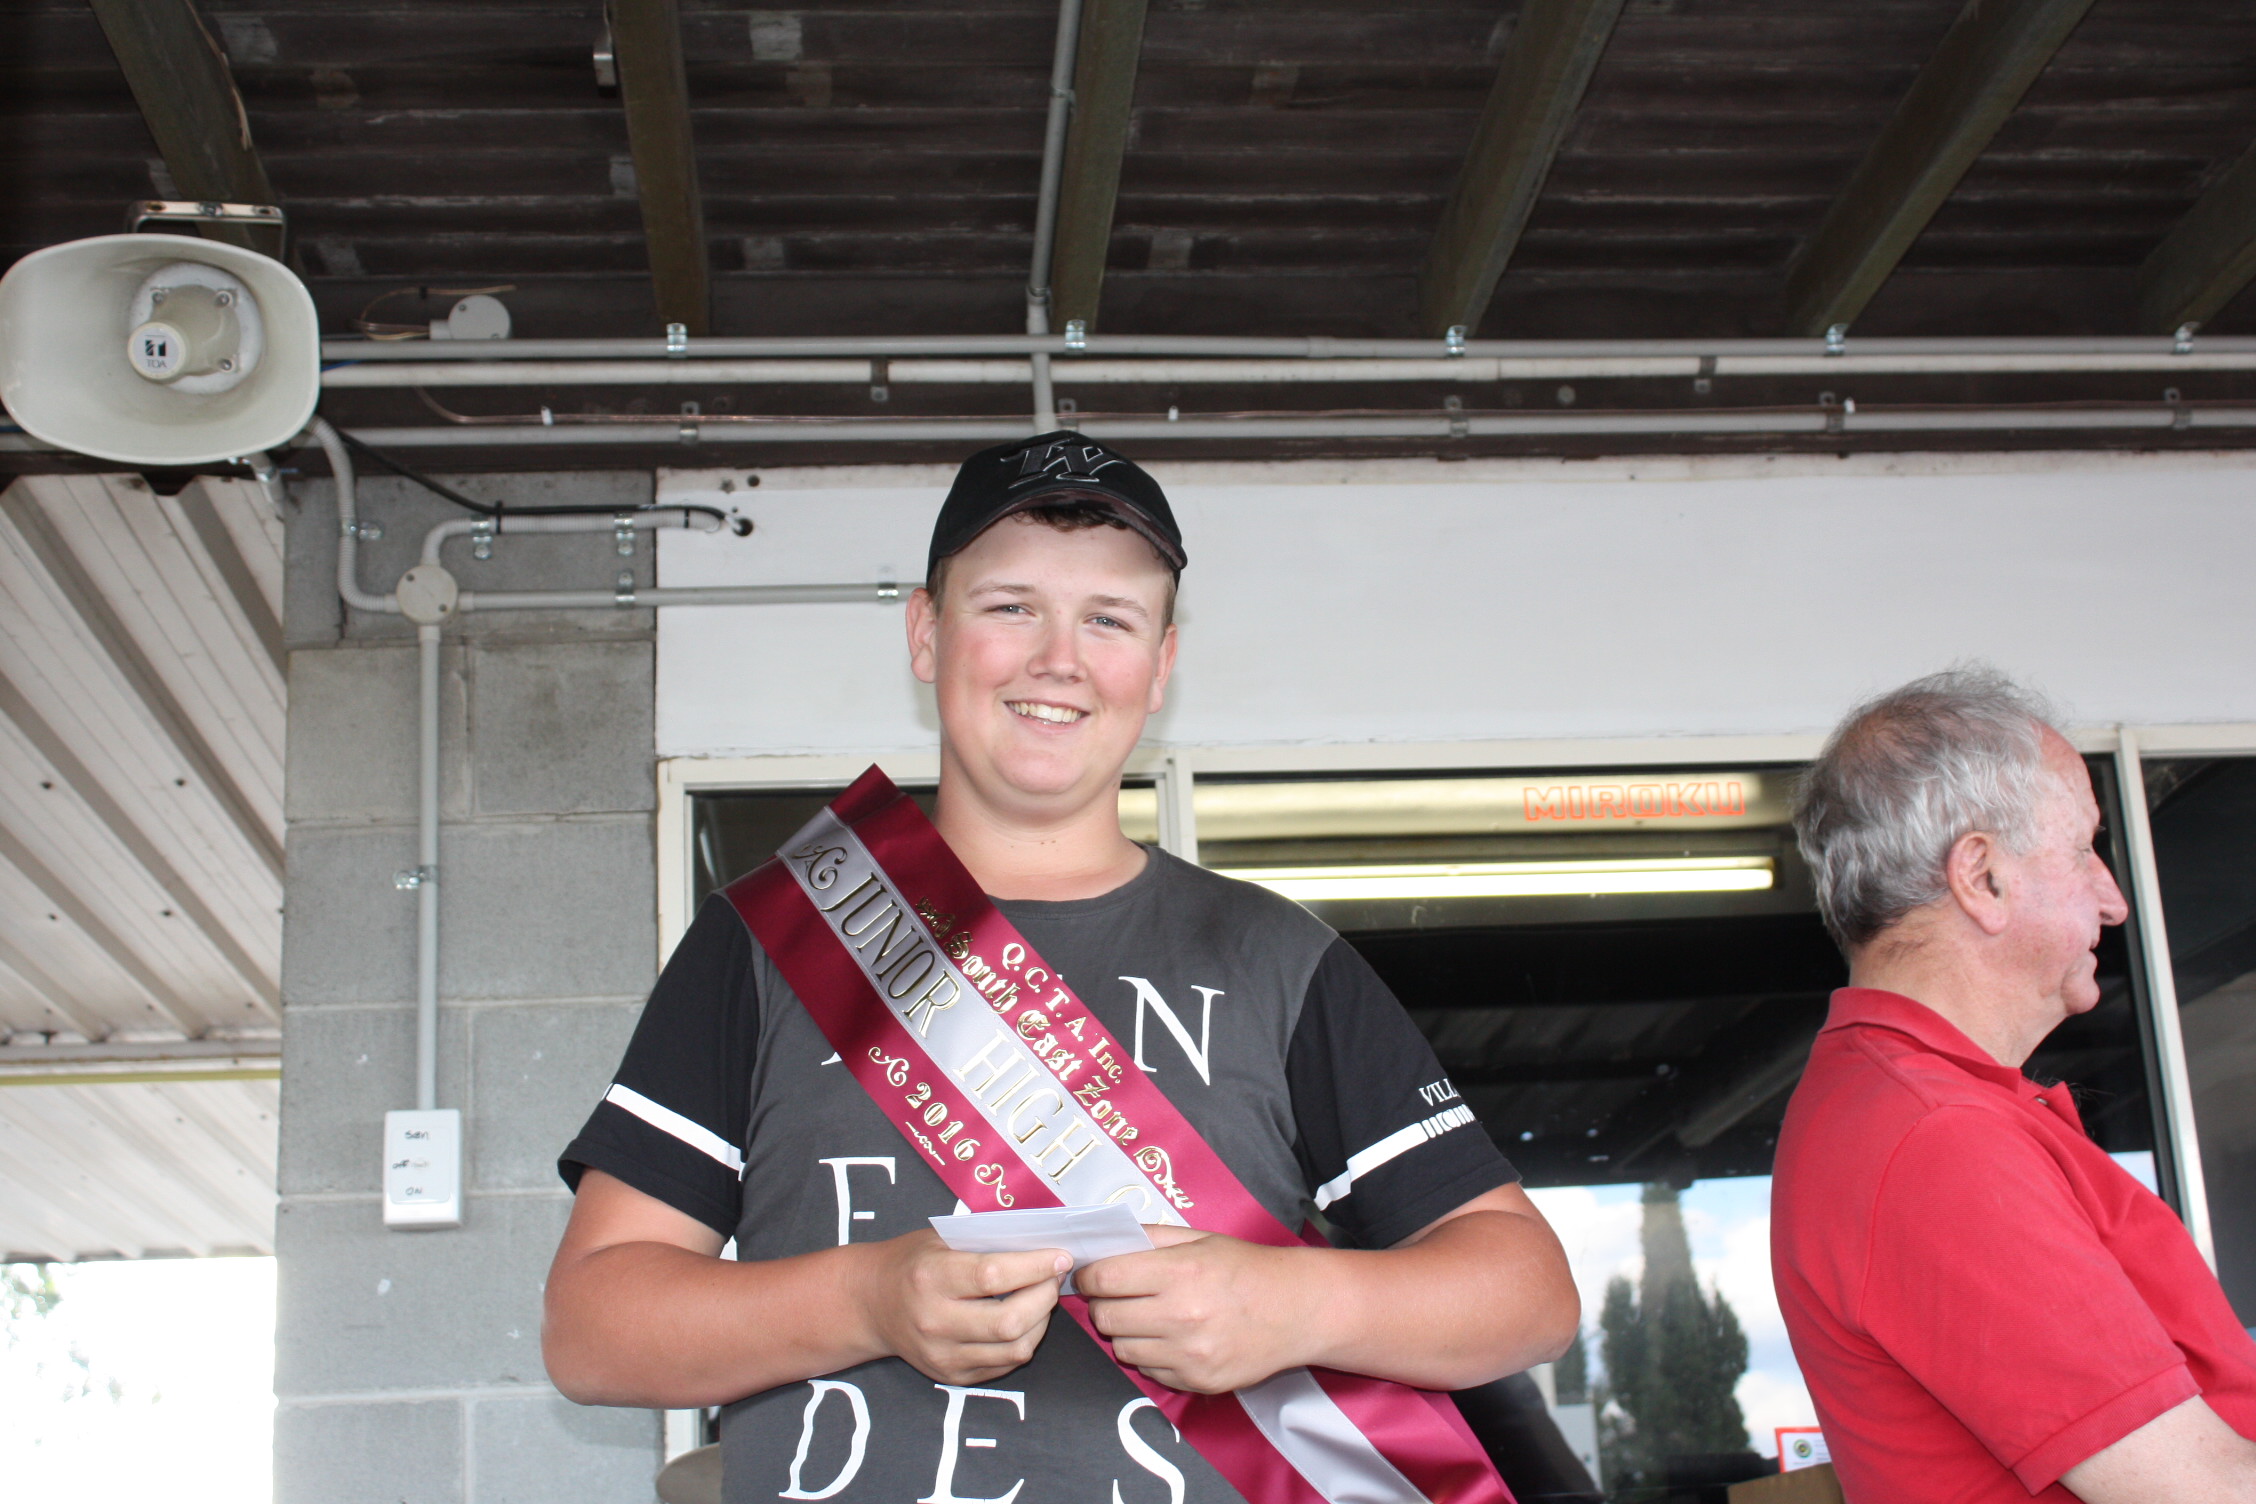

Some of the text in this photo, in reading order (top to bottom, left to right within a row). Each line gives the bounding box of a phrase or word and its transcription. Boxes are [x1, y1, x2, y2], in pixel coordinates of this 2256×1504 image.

[1523, 781, 1746, 821] MIROKU
[822, 872, 1104, 1186] JUNIOR HIGH
[944, 931, 1018, 1014] South
[1015, 1009, 1083, 1082] East
[1072, 1075, 1139, 1147] Zone
[904, 1081, 982, 1162] 2016
